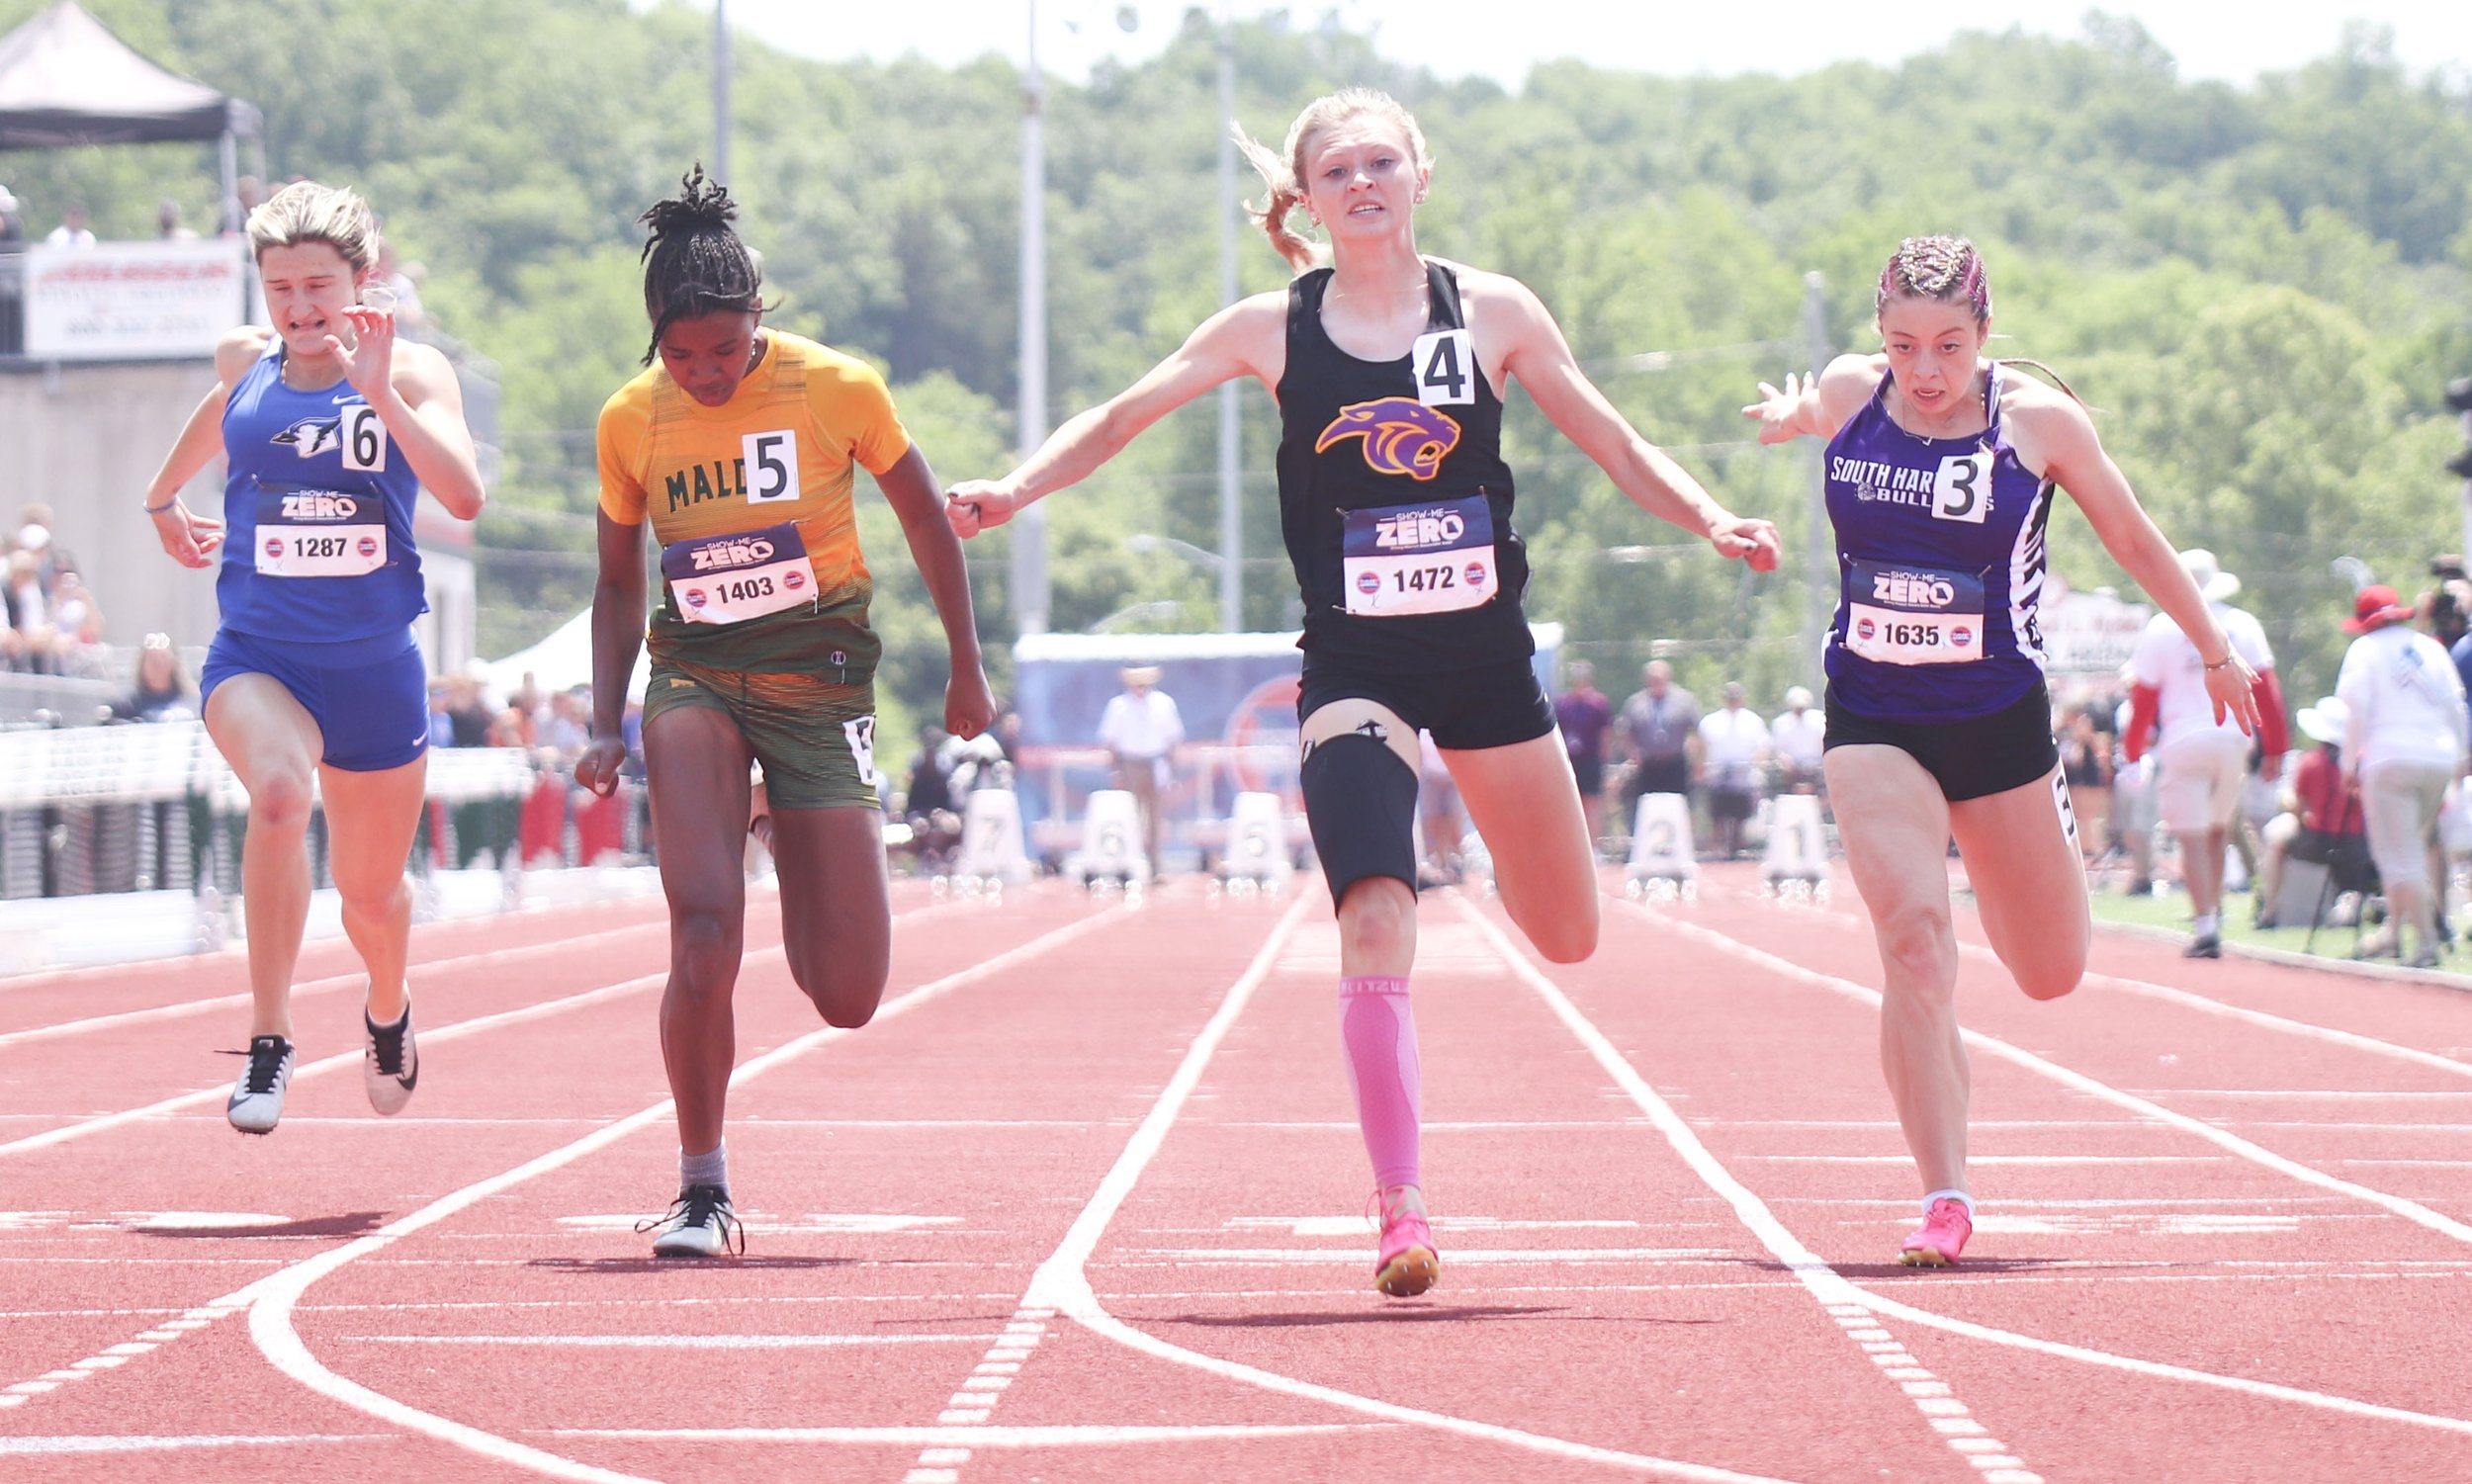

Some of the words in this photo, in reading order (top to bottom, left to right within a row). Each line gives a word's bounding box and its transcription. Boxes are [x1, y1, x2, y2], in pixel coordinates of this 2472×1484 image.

[1424, 336, 1465, 397] 4
[353, 408, 378, 467] 6
[756, 435, 787, 497] 5
[1830, 456, 1892, 487] SOUTH
[300, 489, 339, 498] SHOW-ME
[1943, 459, 1979, 516] 3
[281, 496, 357, 517] ZERO
[1396, 507, 1445, 521] SHOW-ME
[706, 537, 752, 550] SHOW-ME
[1375, 514, 1464, 548] ZERO
[295, 538, 347, 557] 1287
[690, 540, 774, 570] ZERO
[716, 576, 774, 604] 1403
[1393, 566, 1455, 592] 1472
[1873, 575, 1954, 606] ZERO
[1891, 570, 1935, 581] SHOW-ME
[1885, 623, 1939, 646] 1635
[1648, 820, 1675, 856] 2
[1786, 820, 1805, 857] 1
